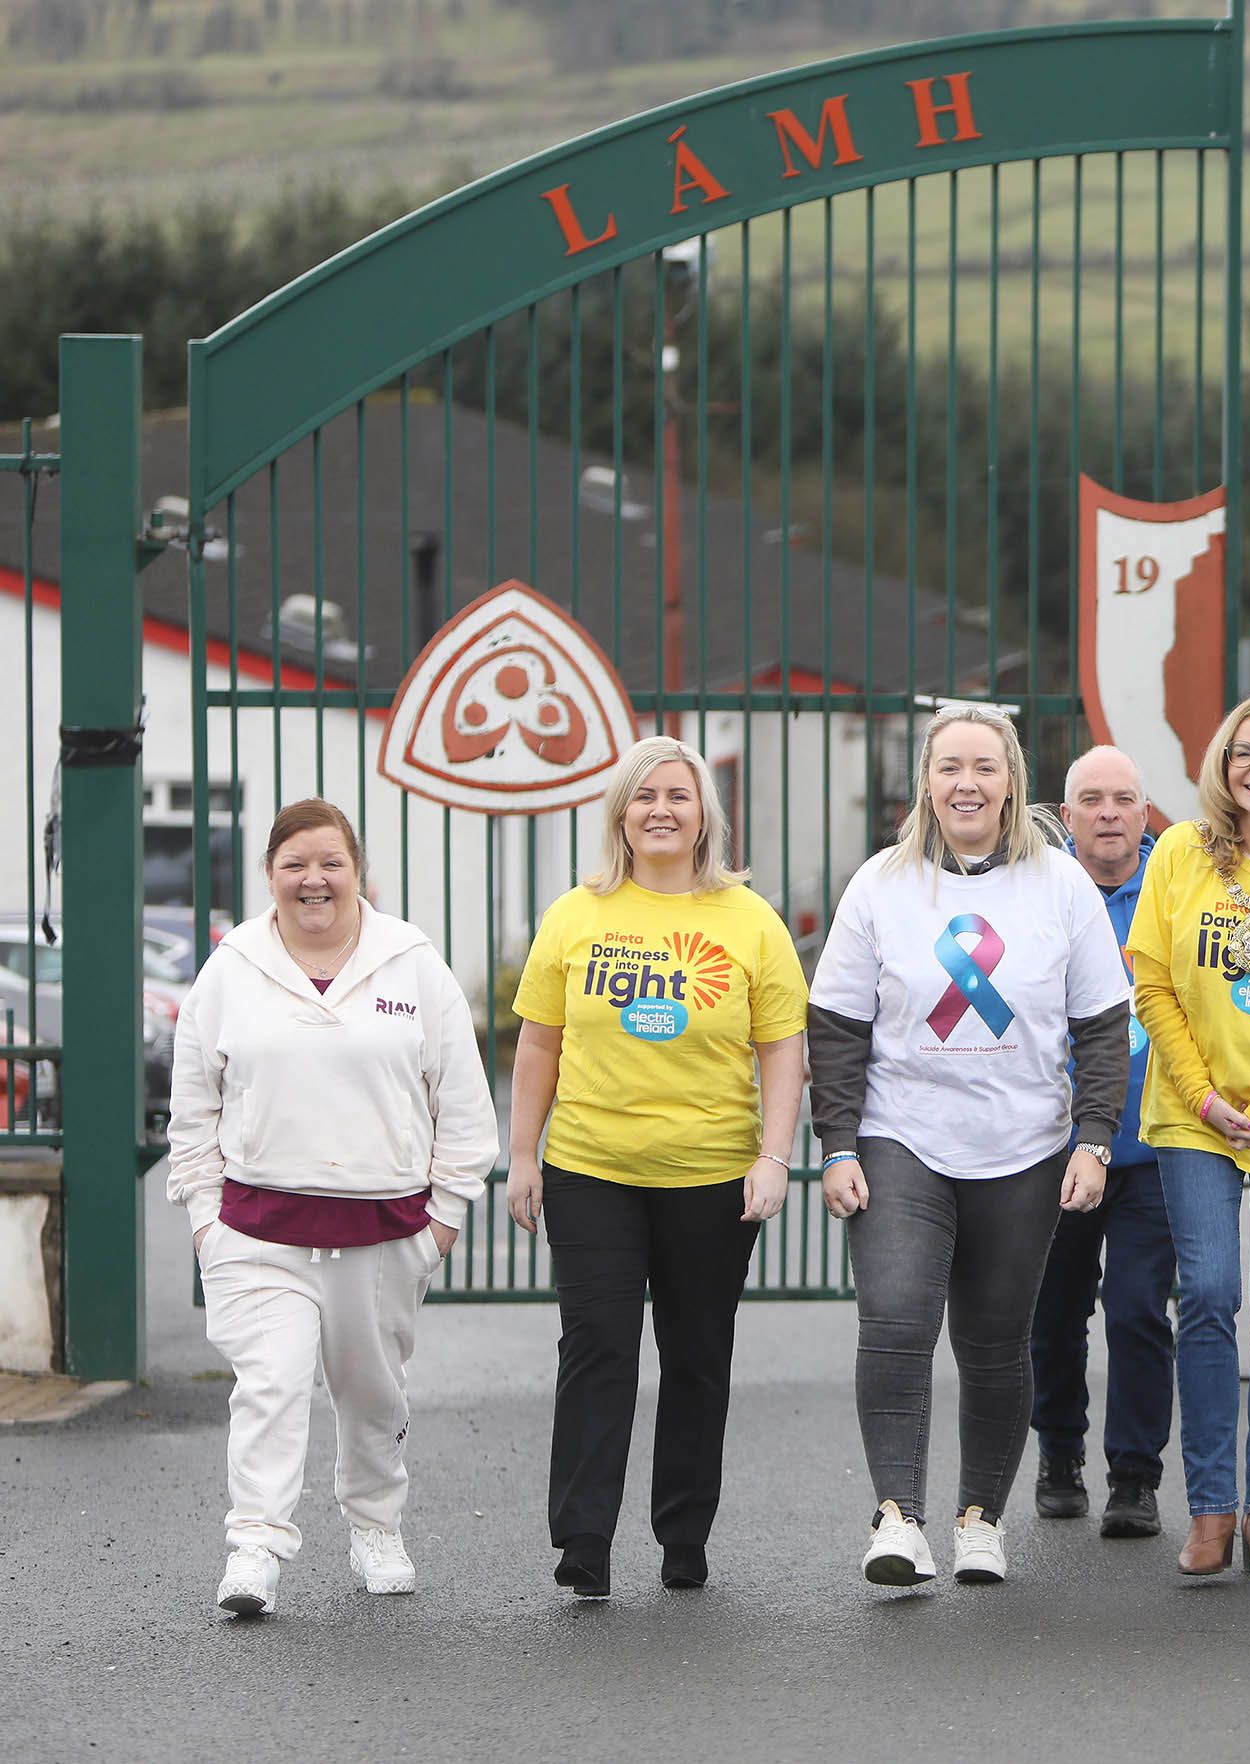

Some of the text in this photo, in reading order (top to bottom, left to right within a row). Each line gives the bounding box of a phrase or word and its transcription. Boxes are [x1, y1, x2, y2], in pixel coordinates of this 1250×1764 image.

[540, 71, 983, 256] LÁMH
[1113, 556, 1160, 595] 19
[604, 932, 644, 944] pieta
[591, 944, 670, 962] Darkness
[615, 960, 639, 970] into
[584, 960, 687, 1008] light
[628, 1011, 675, 1023] electric
[636, 1022, 675, 1034] Ireland
[919, 1044, 940, 1052] Suicide
[979, 1045, 1001, 1053] Support
